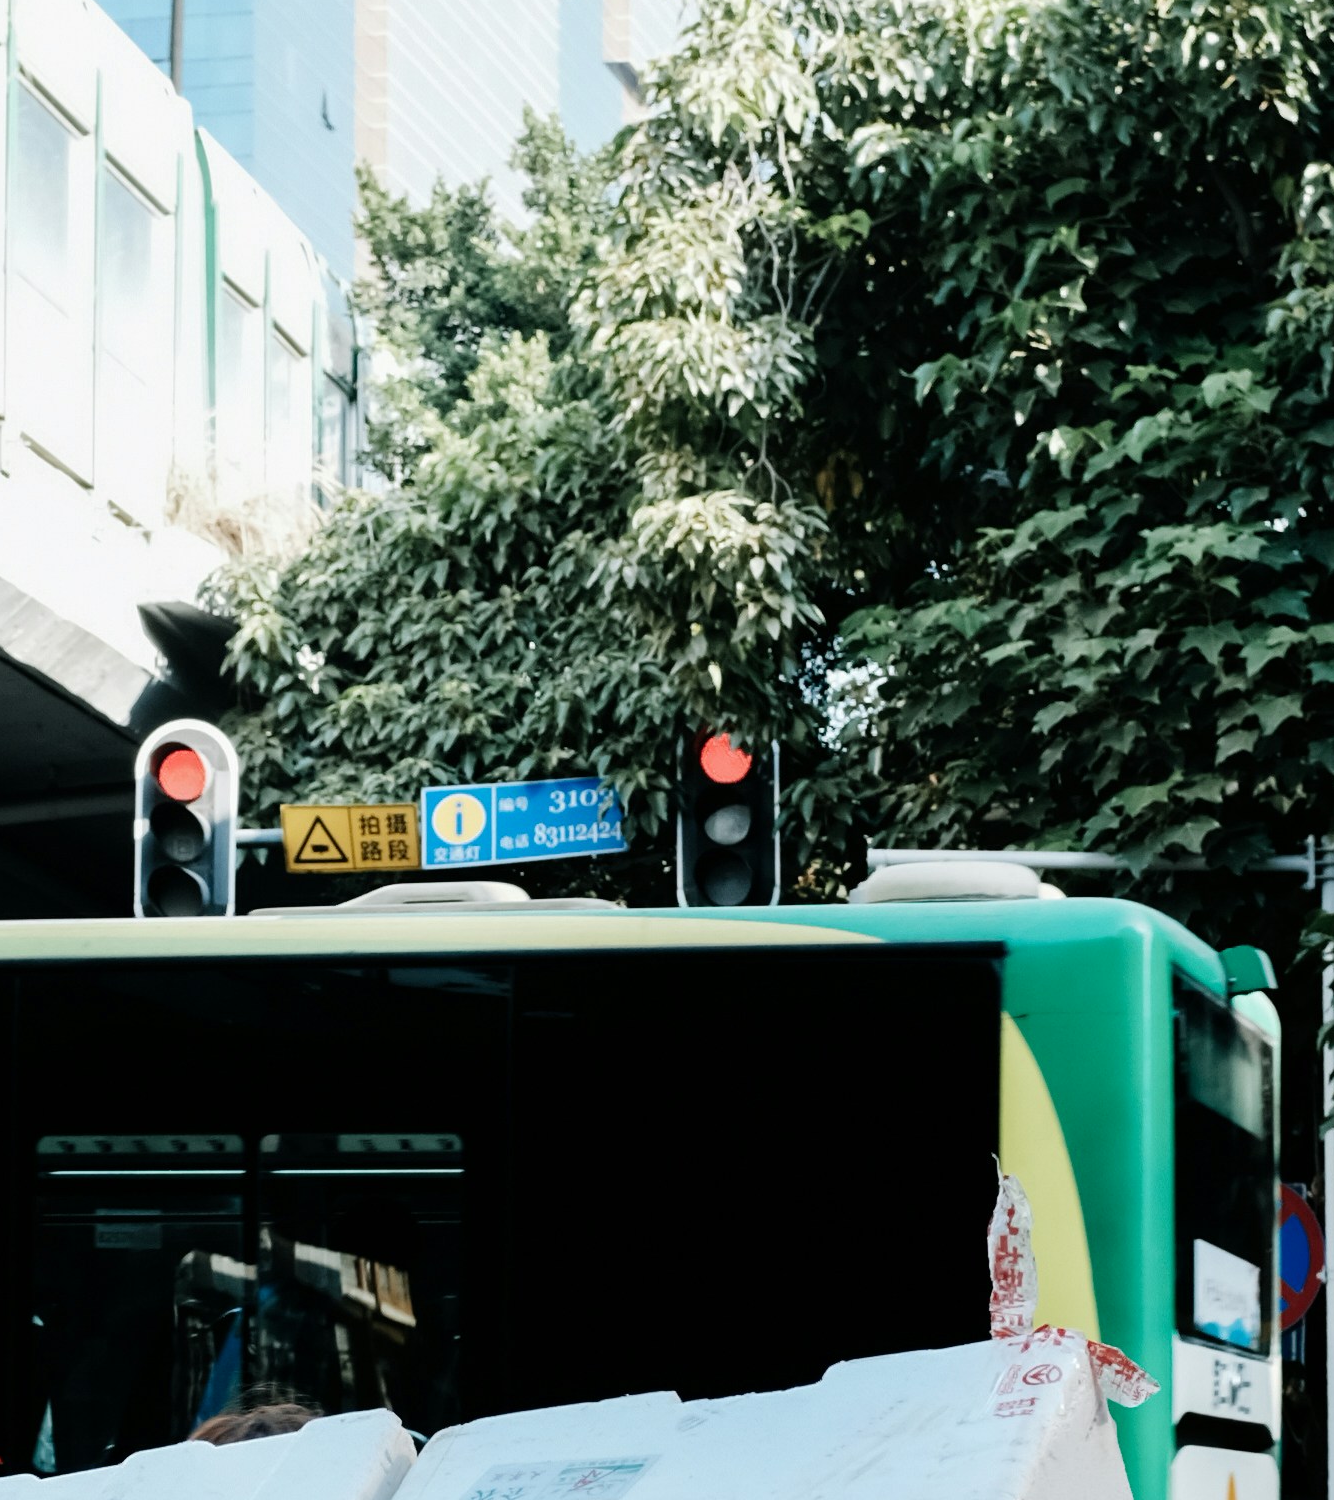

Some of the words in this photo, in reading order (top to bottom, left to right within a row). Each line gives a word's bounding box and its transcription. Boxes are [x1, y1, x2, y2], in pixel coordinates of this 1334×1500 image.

[359, 813, 408, 836] 拍摄
[533, 820, 622, 848] 83112424
[360, 839, 410, 862] 路段
